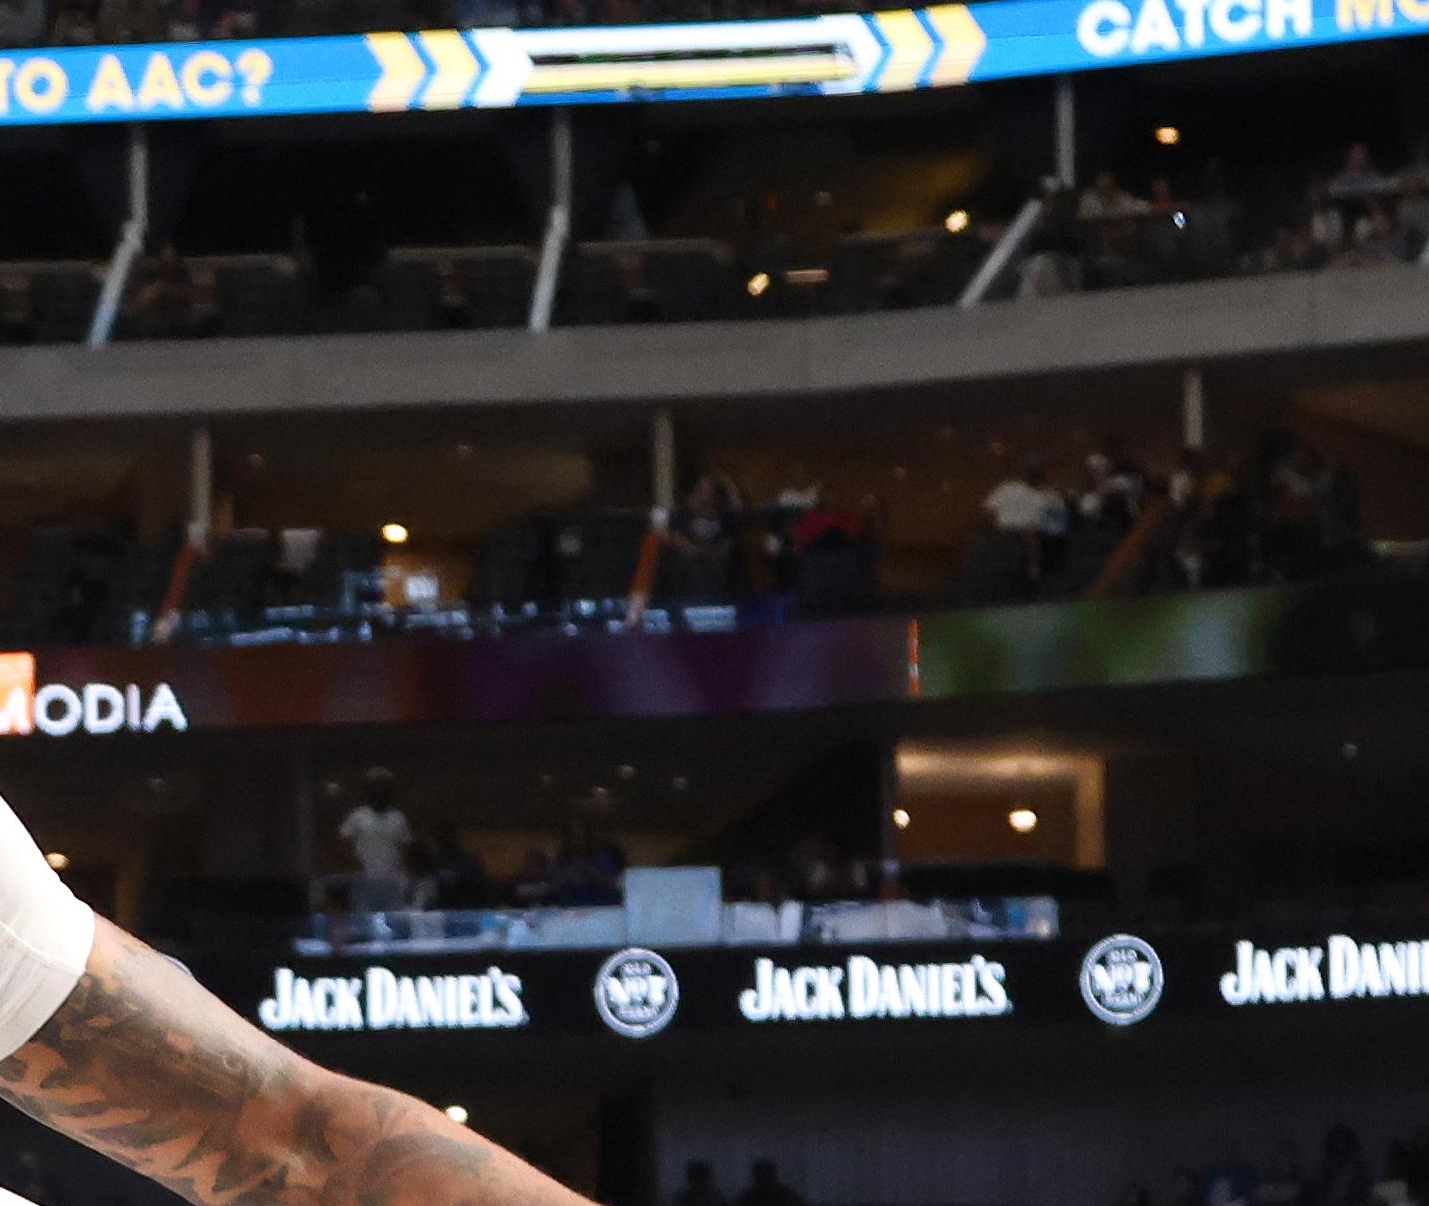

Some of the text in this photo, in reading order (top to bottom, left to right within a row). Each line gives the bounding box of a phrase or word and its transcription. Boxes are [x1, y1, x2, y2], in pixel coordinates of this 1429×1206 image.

[1075, 0, 1314, 58] CATCH
[85, 49, 275, 112] AAC?
[258, 965, 529, 1030] JACK DANIEL'S
[739, 956, 844, 1022] JACK
[848, 954, 1012, 1018] DANIEL'S
[1218, 939, 1326, 1006] JACK
